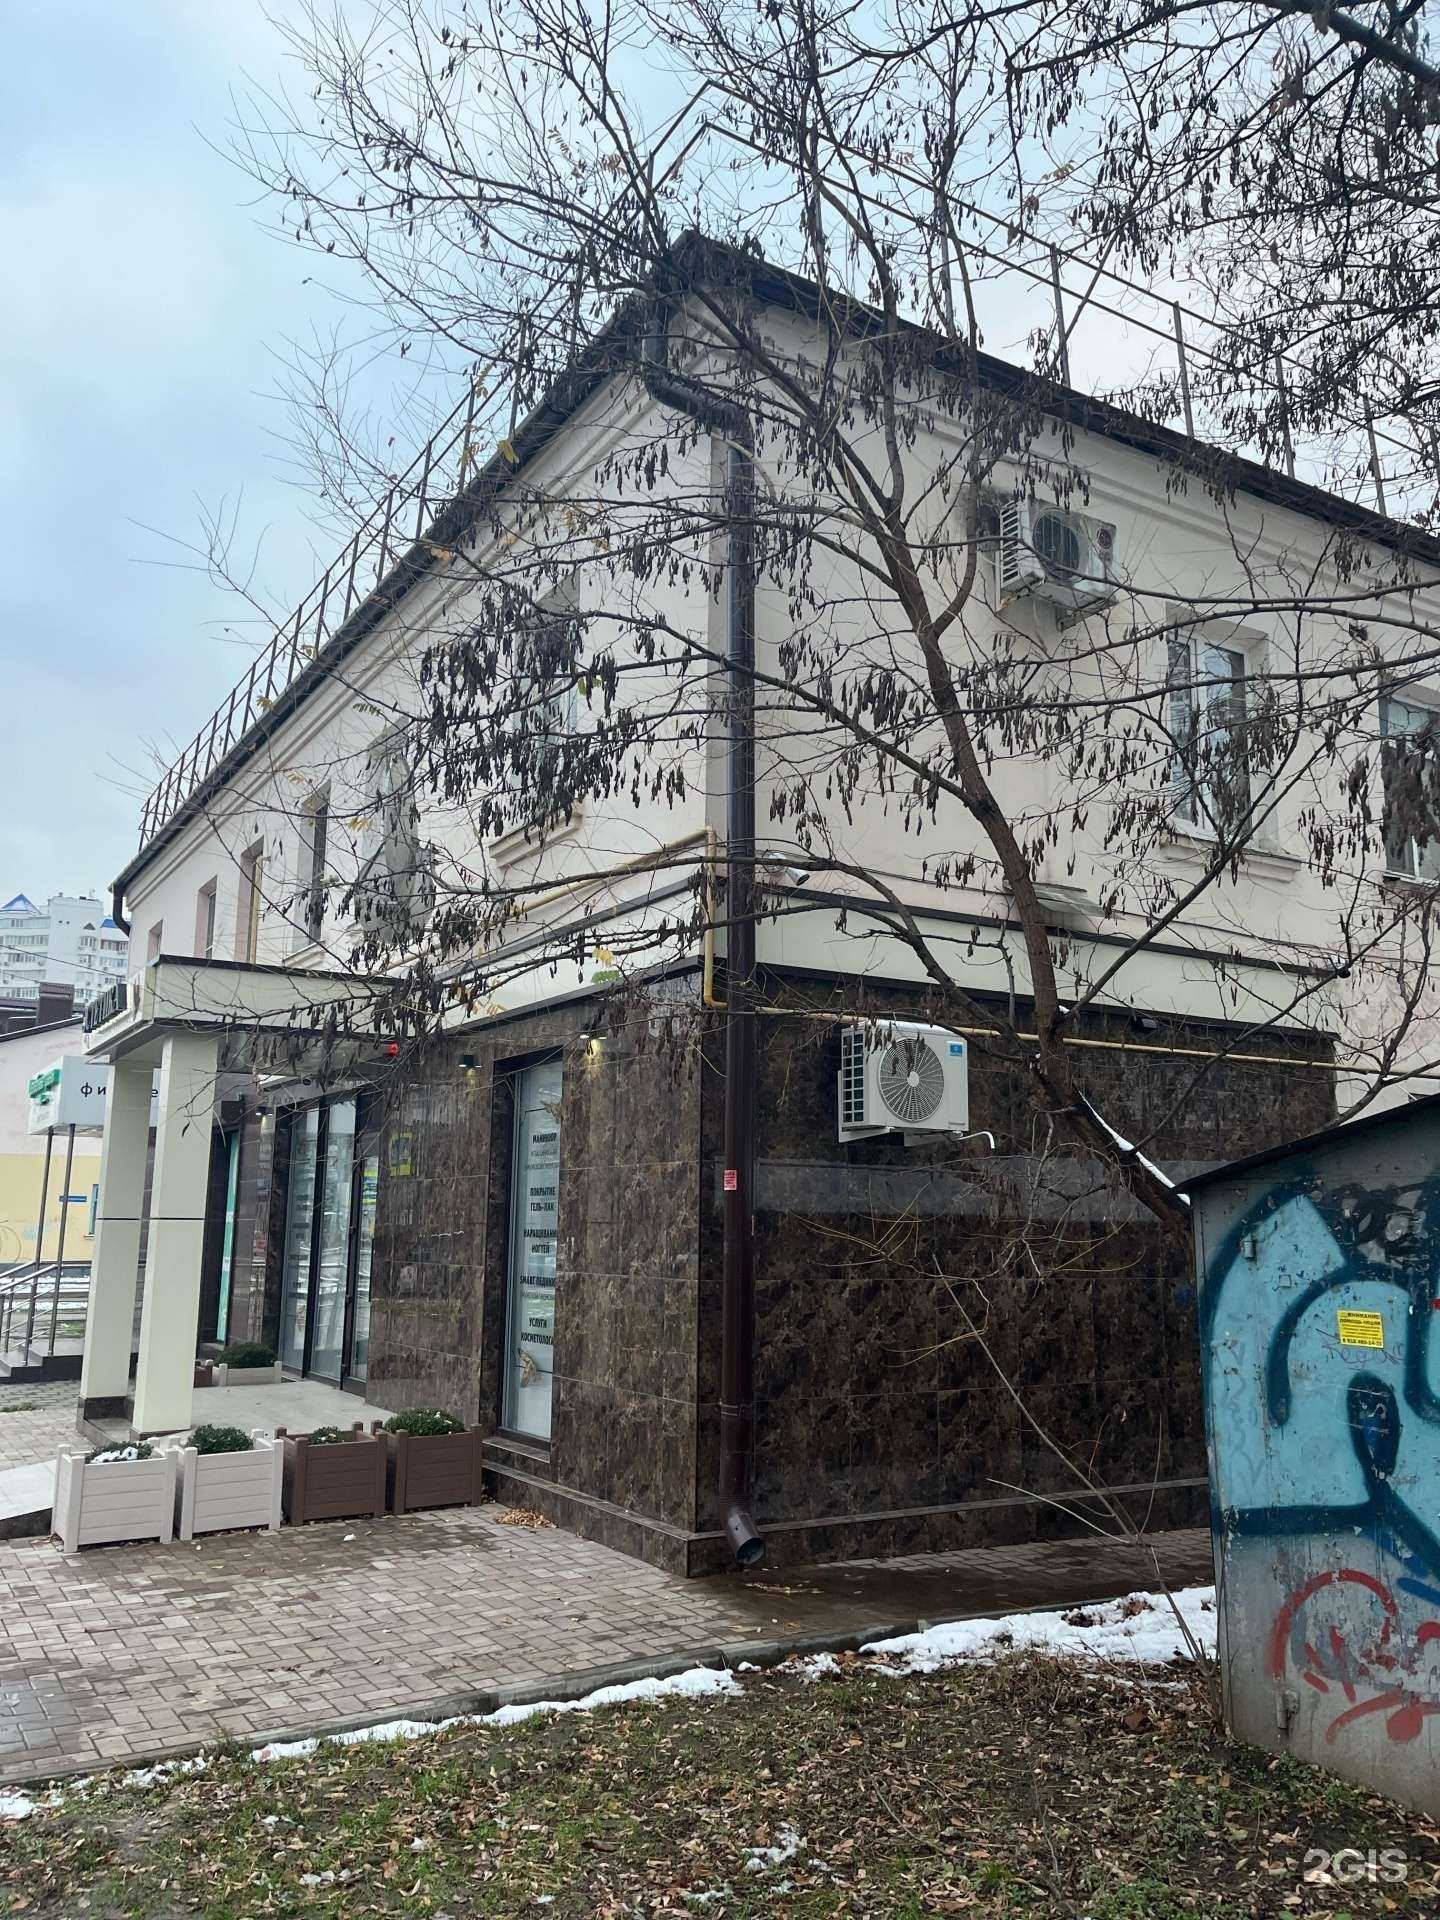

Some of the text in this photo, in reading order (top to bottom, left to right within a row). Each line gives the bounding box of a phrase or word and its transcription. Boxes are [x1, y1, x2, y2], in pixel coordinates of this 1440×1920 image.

[529, 1186, 556, 1197] ПОКРЫТИЕ
[530, 1202, 555, 1212] ГЕЛЬ-ЛАК
[531, 1242, 550, 1254] НОГТЕЙ
[528, 1317, 548, 1329] УСЛУГИ
